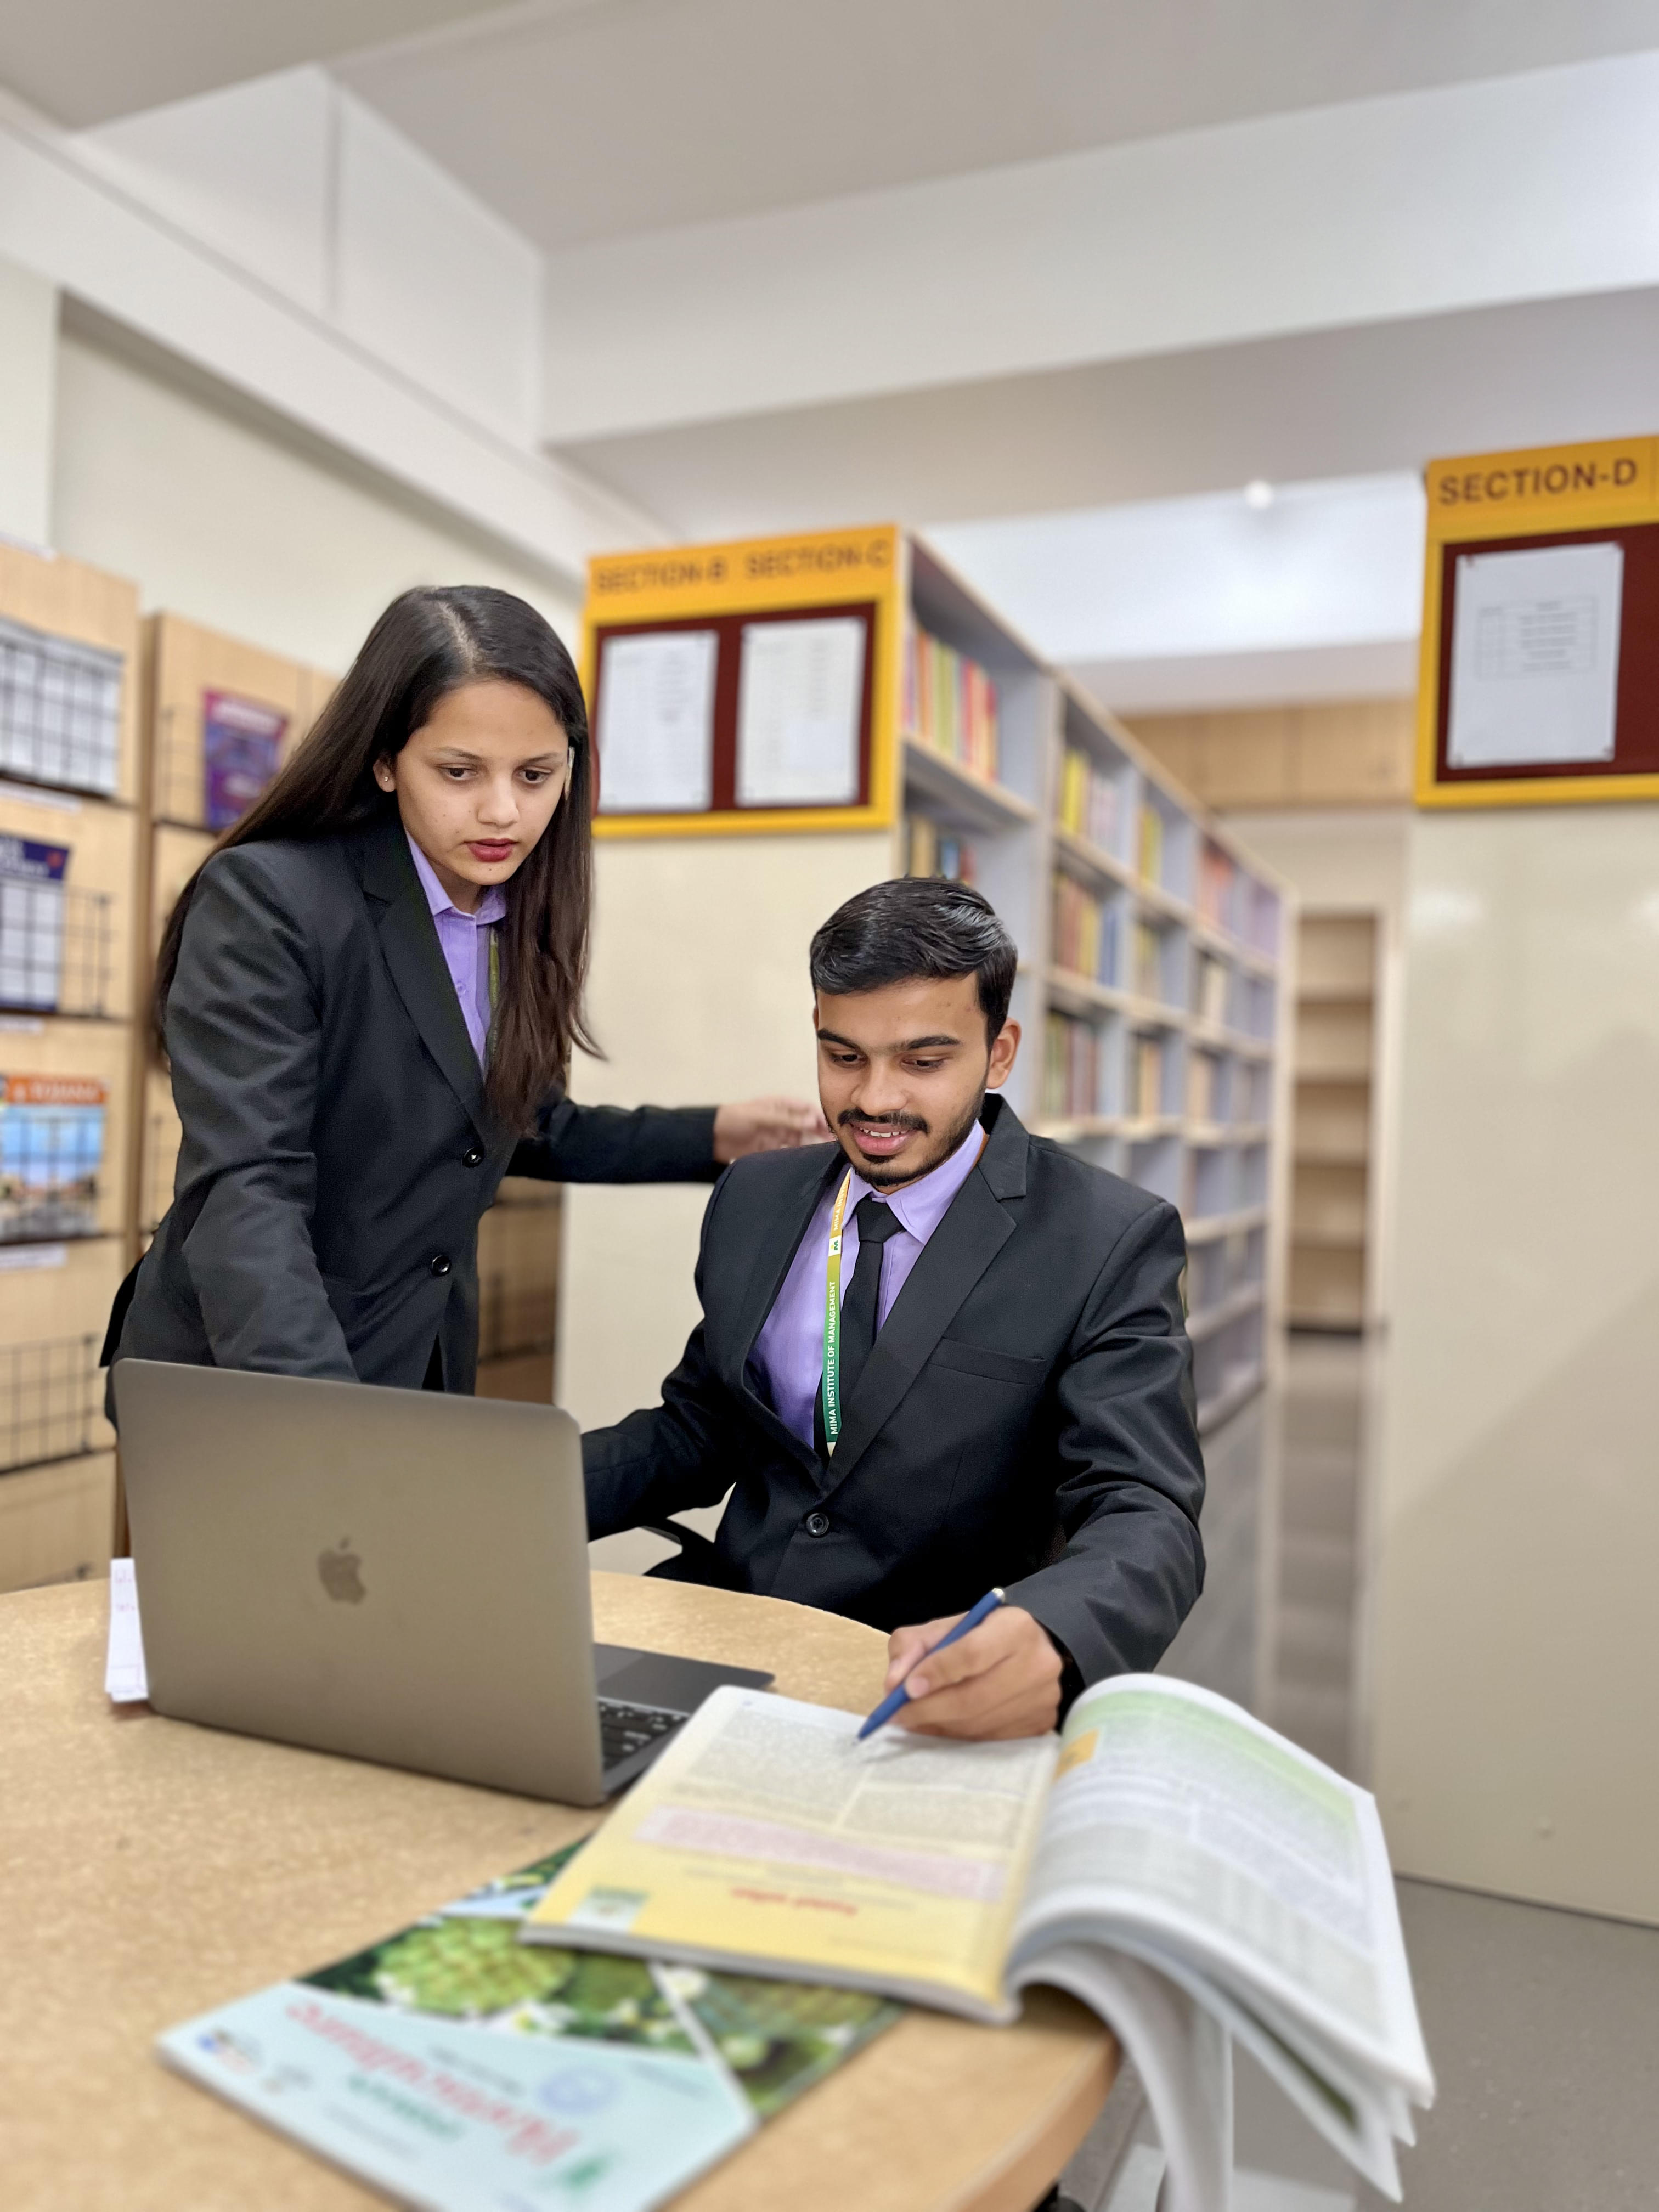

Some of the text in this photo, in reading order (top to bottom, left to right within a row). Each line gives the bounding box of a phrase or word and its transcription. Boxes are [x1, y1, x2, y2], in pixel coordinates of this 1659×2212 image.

[1439, 458, 1638, 505] SECTION-D
[744, 541, 893, 580] SECTION-C
[827, 1281, 838, 1435] MIMA INSTITUTE OF MANAGEMENT
